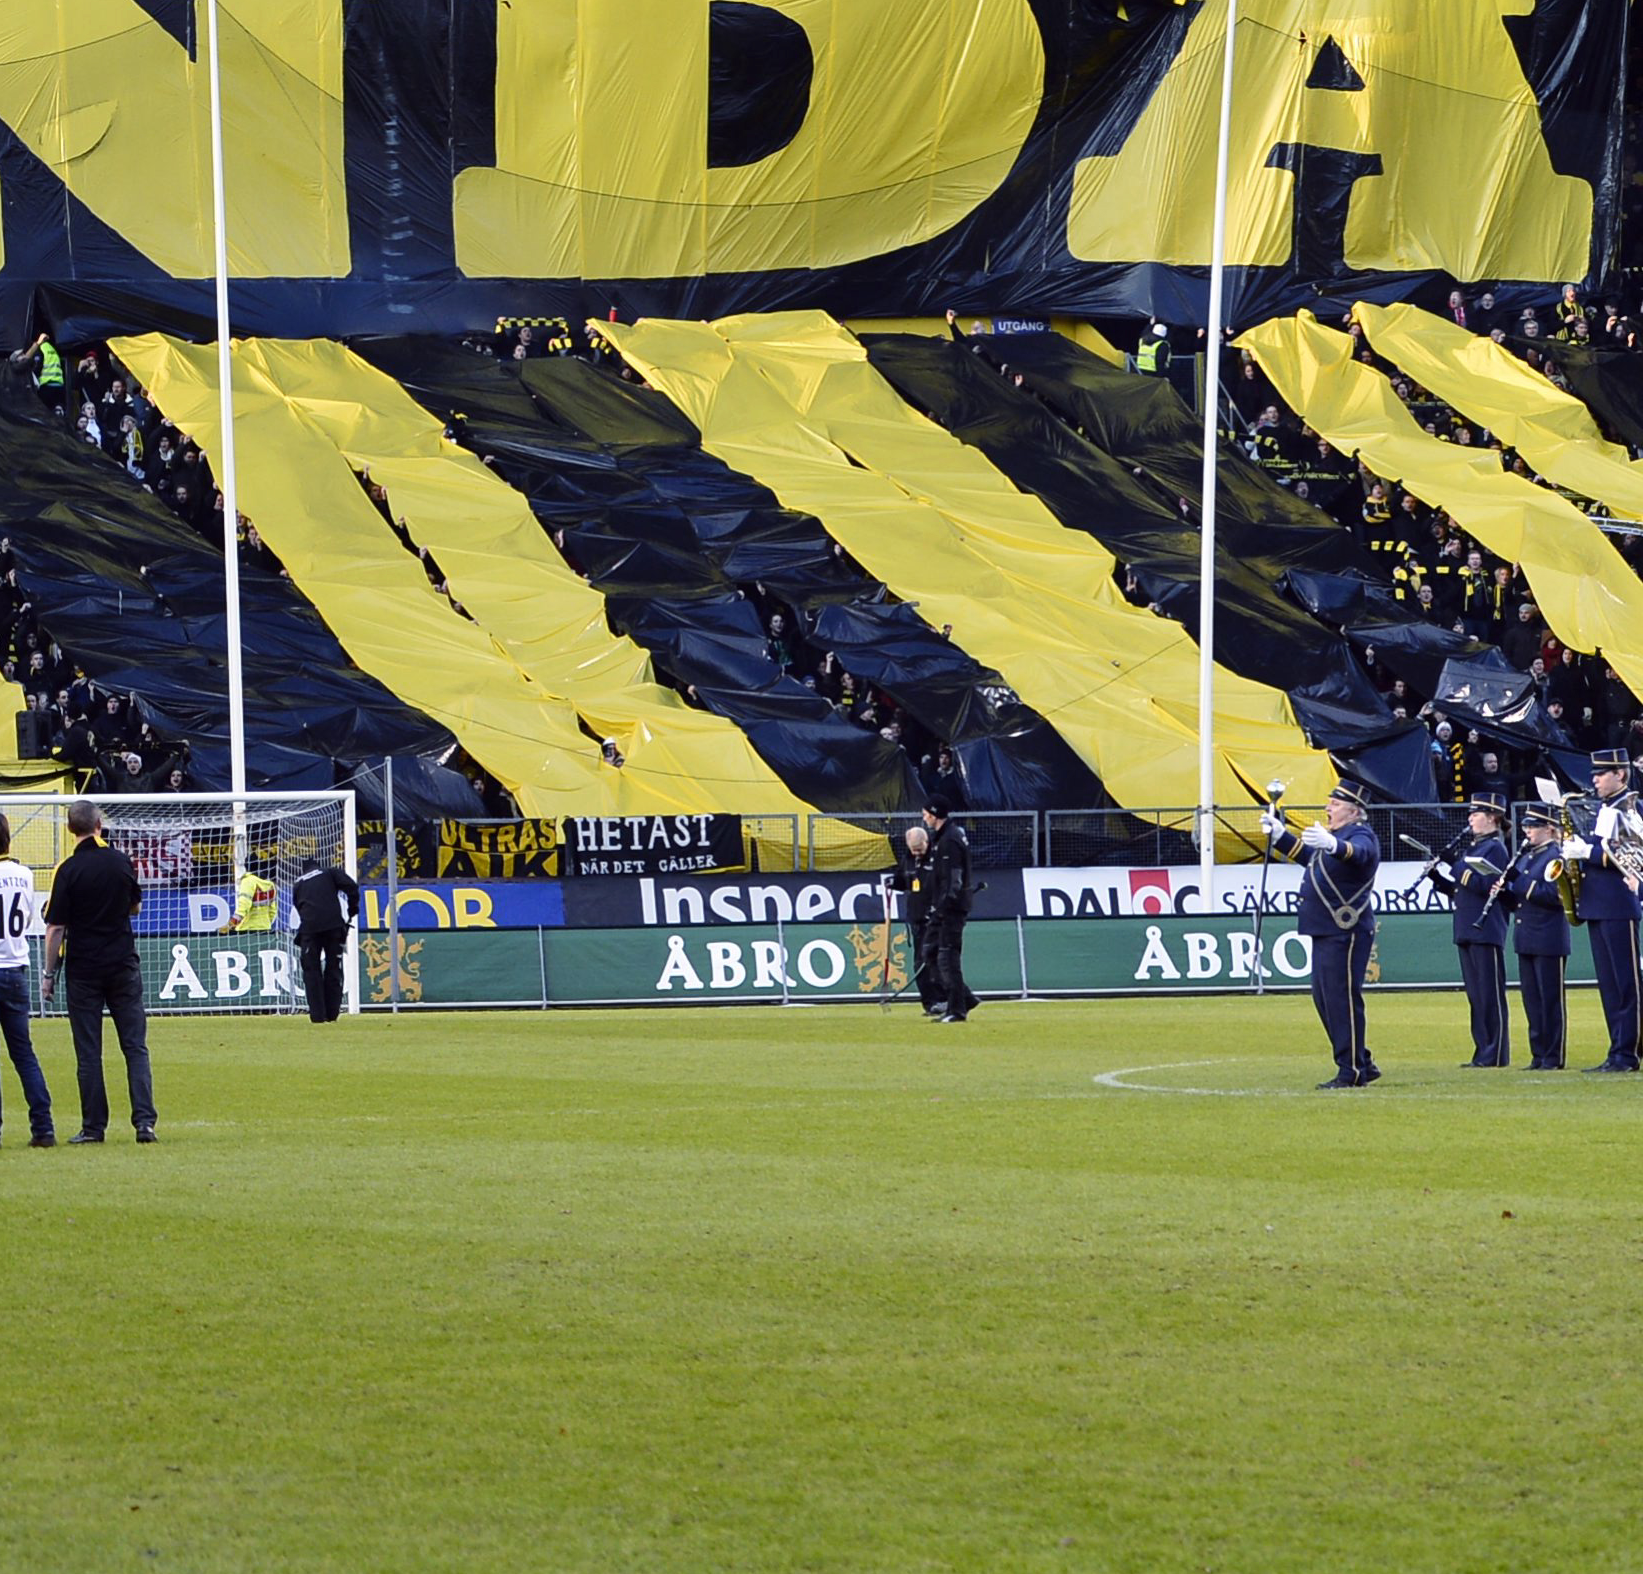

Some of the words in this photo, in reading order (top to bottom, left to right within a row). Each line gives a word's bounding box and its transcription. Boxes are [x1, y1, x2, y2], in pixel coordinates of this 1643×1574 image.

[998, 320, 1044, 333] UTGÅNG
[440, 817, 557, 853] ULTRAS
[575, 814, 715, 852] HETAST
[442, 851, 555, 878] AIK
[580, 860, 611, 876] NÄR
[612, 858, 646, 875] DET
[658, 853, 718, 873] GÄLLER
[158, 943, 351, 1000] ÅBR
[655, 934, 846, 991] ÅBRO
[1133, 925, 1315, 981] ÅBRO
